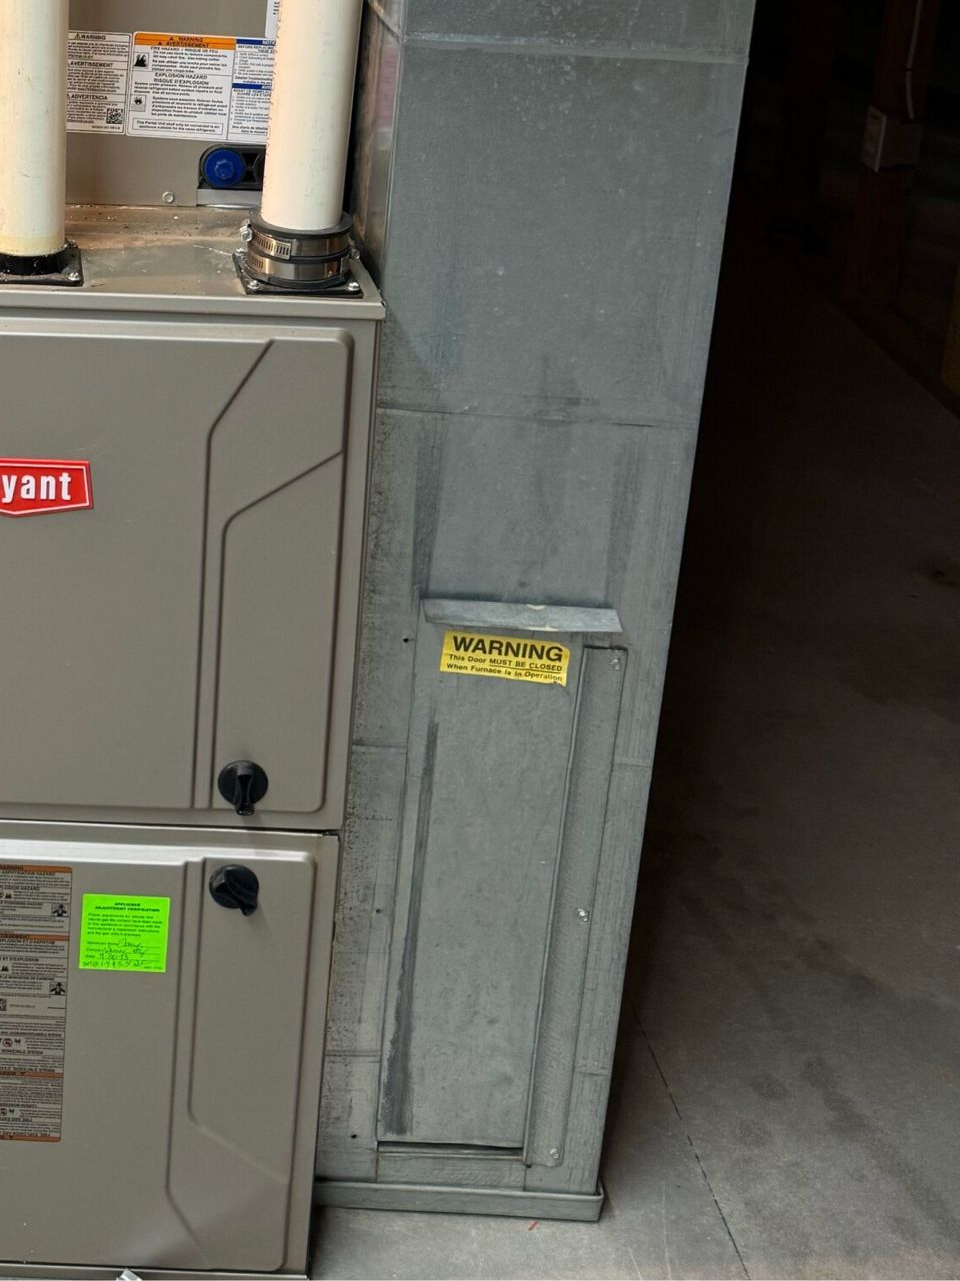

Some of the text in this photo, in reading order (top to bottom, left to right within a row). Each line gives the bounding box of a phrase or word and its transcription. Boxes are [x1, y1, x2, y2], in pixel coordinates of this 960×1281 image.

[453, 635, 563, 662] WARNING
[447, 663, 563, 682] When Furnace Operation
[468, 656, 486, 664] Door
[489, 658, 512, 666] MUST
[515, 660, 526, 668] BE
[529, 662, 563, 672] CLOSED
